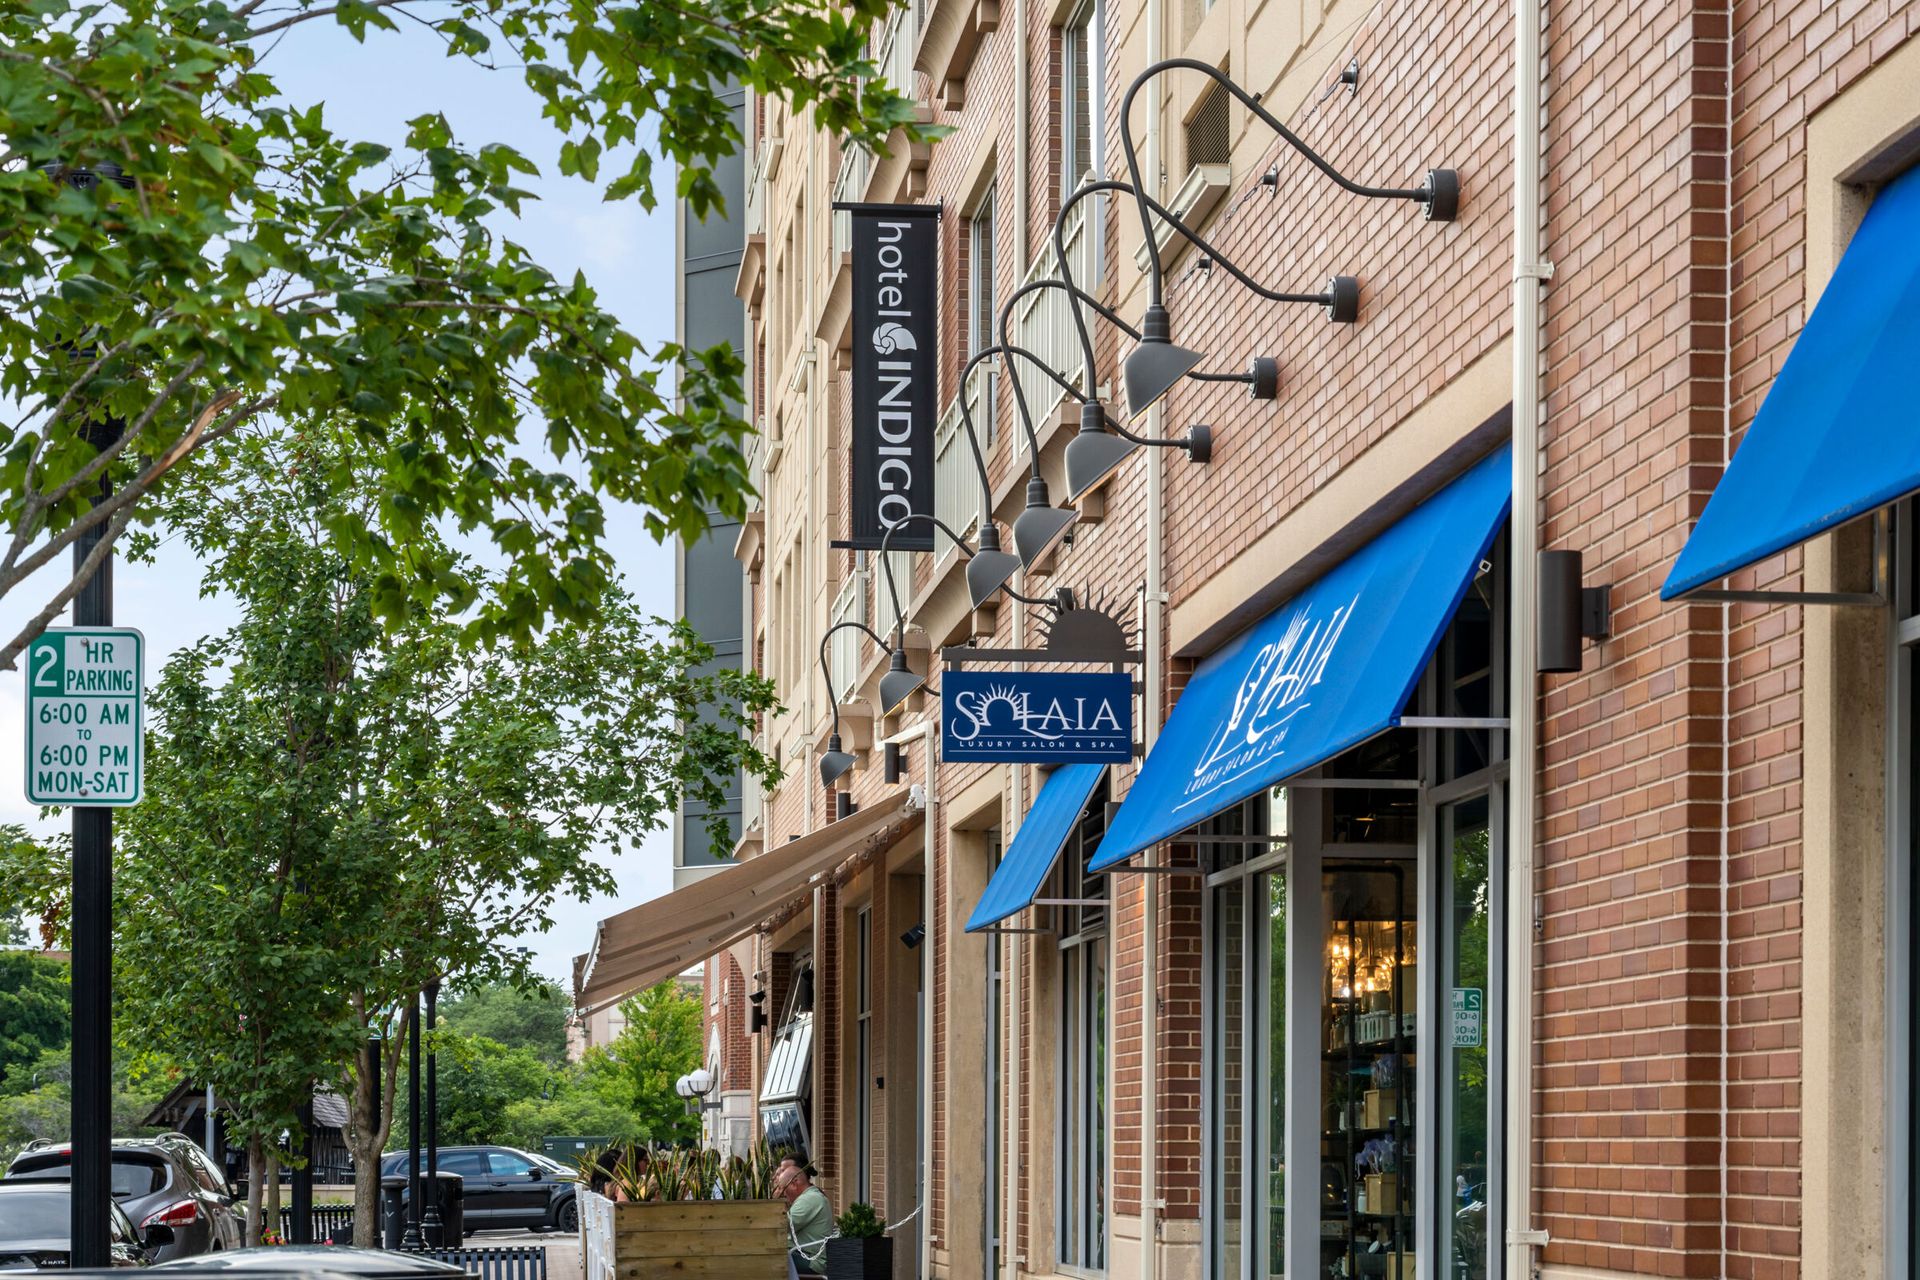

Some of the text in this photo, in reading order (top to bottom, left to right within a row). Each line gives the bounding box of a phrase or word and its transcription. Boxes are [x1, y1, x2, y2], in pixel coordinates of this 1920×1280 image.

[878, 221, 912, 530] hotel INDIGO
[86, 642, 114, 664] HR
[34, 645, 58, 688] 2
[66, 669, 133, 691] PARKING
[39, 703, 130, 725] 6:00 AM
[951, 682, 1122, 740] SOLAIA
[76, 729, 92, 741] TO
[40, 745, 129, 767] 6:00 PM
[38, 771, 130, 794] MON-SAT
